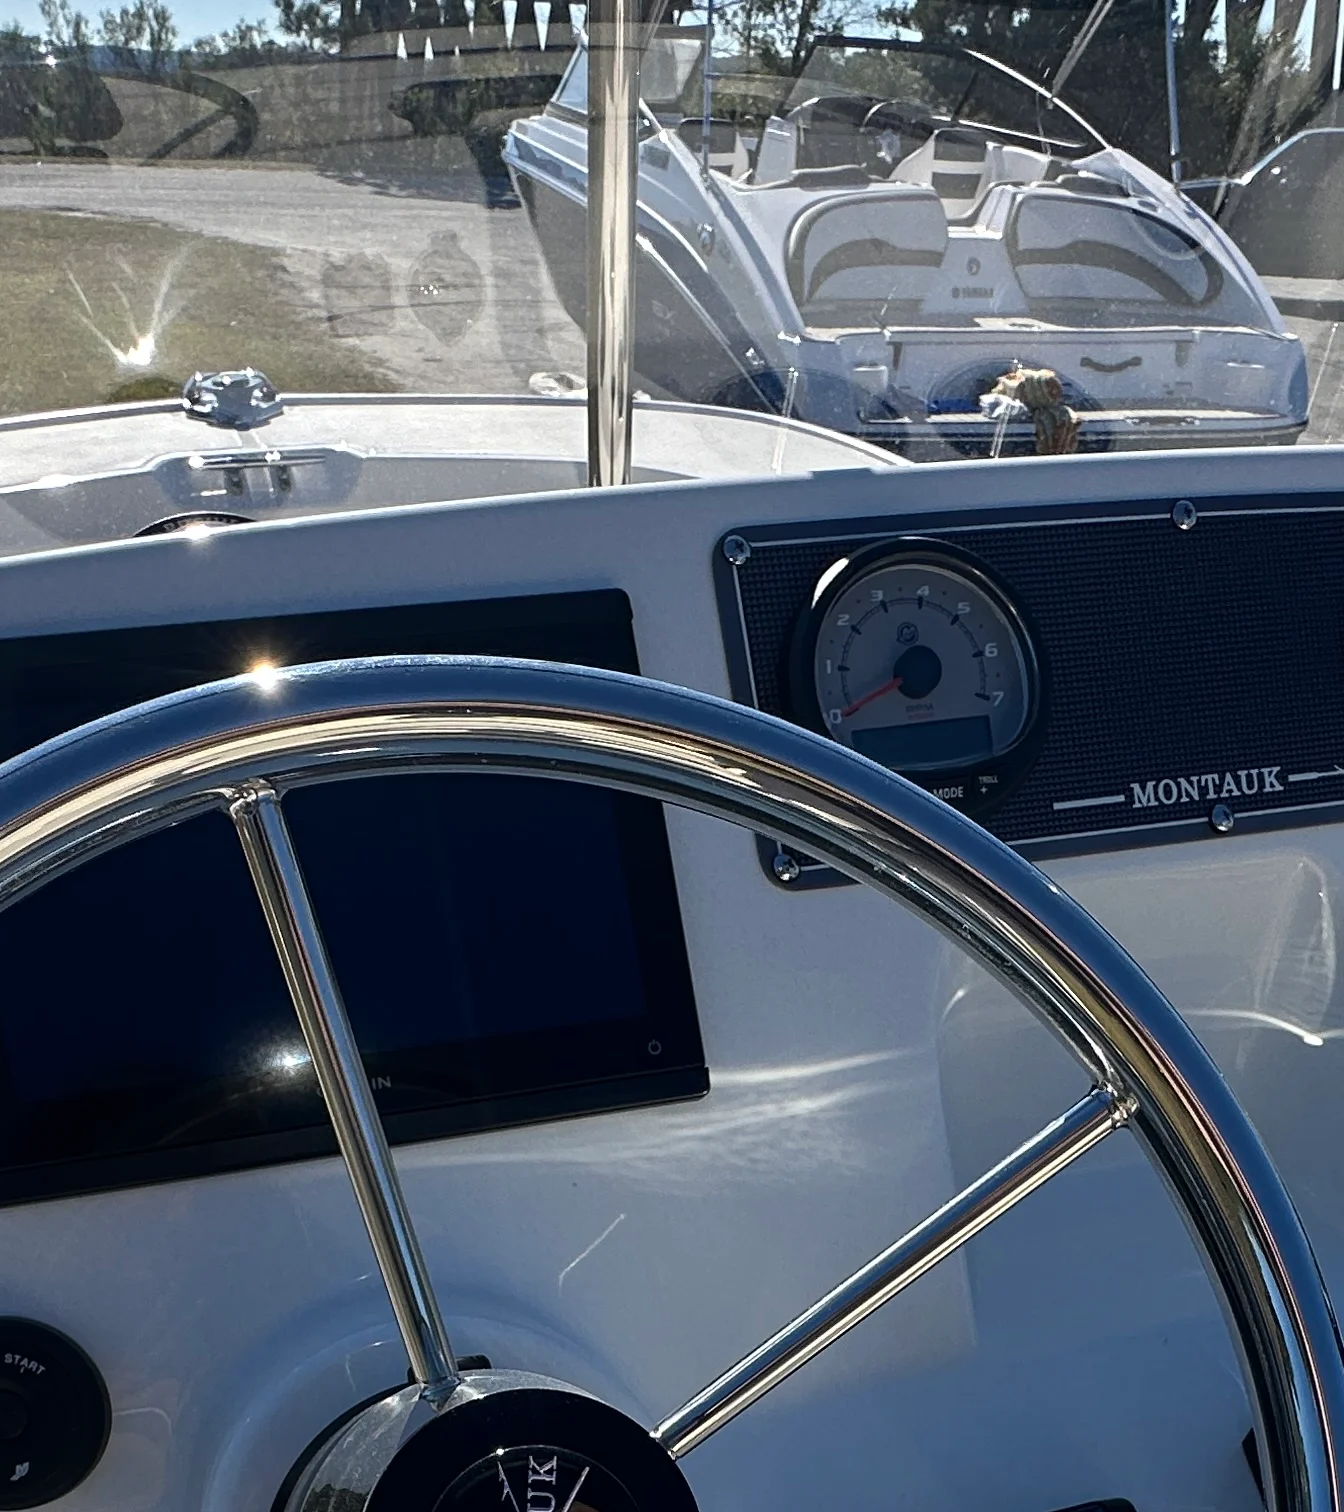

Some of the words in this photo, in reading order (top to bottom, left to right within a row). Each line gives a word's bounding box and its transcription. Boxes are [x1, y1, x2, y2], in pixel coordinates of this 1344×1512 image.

[871, 590, 883, 602] 3
[916, 585, 930, 597] 4
[957, 602, 971, 613] 5
[836, 614, 850, 626] 2
[984, 643, 998, 657] 6
[826, 660, 832, 674] 1
[992, 692, 1005, 706] 7
[829, 709, 843, 724] 0
[933, 786, 964, 799] MODE
[1130, 766, 1285, 808] MONTAUK
[4, 1352, 47, 1376] START
